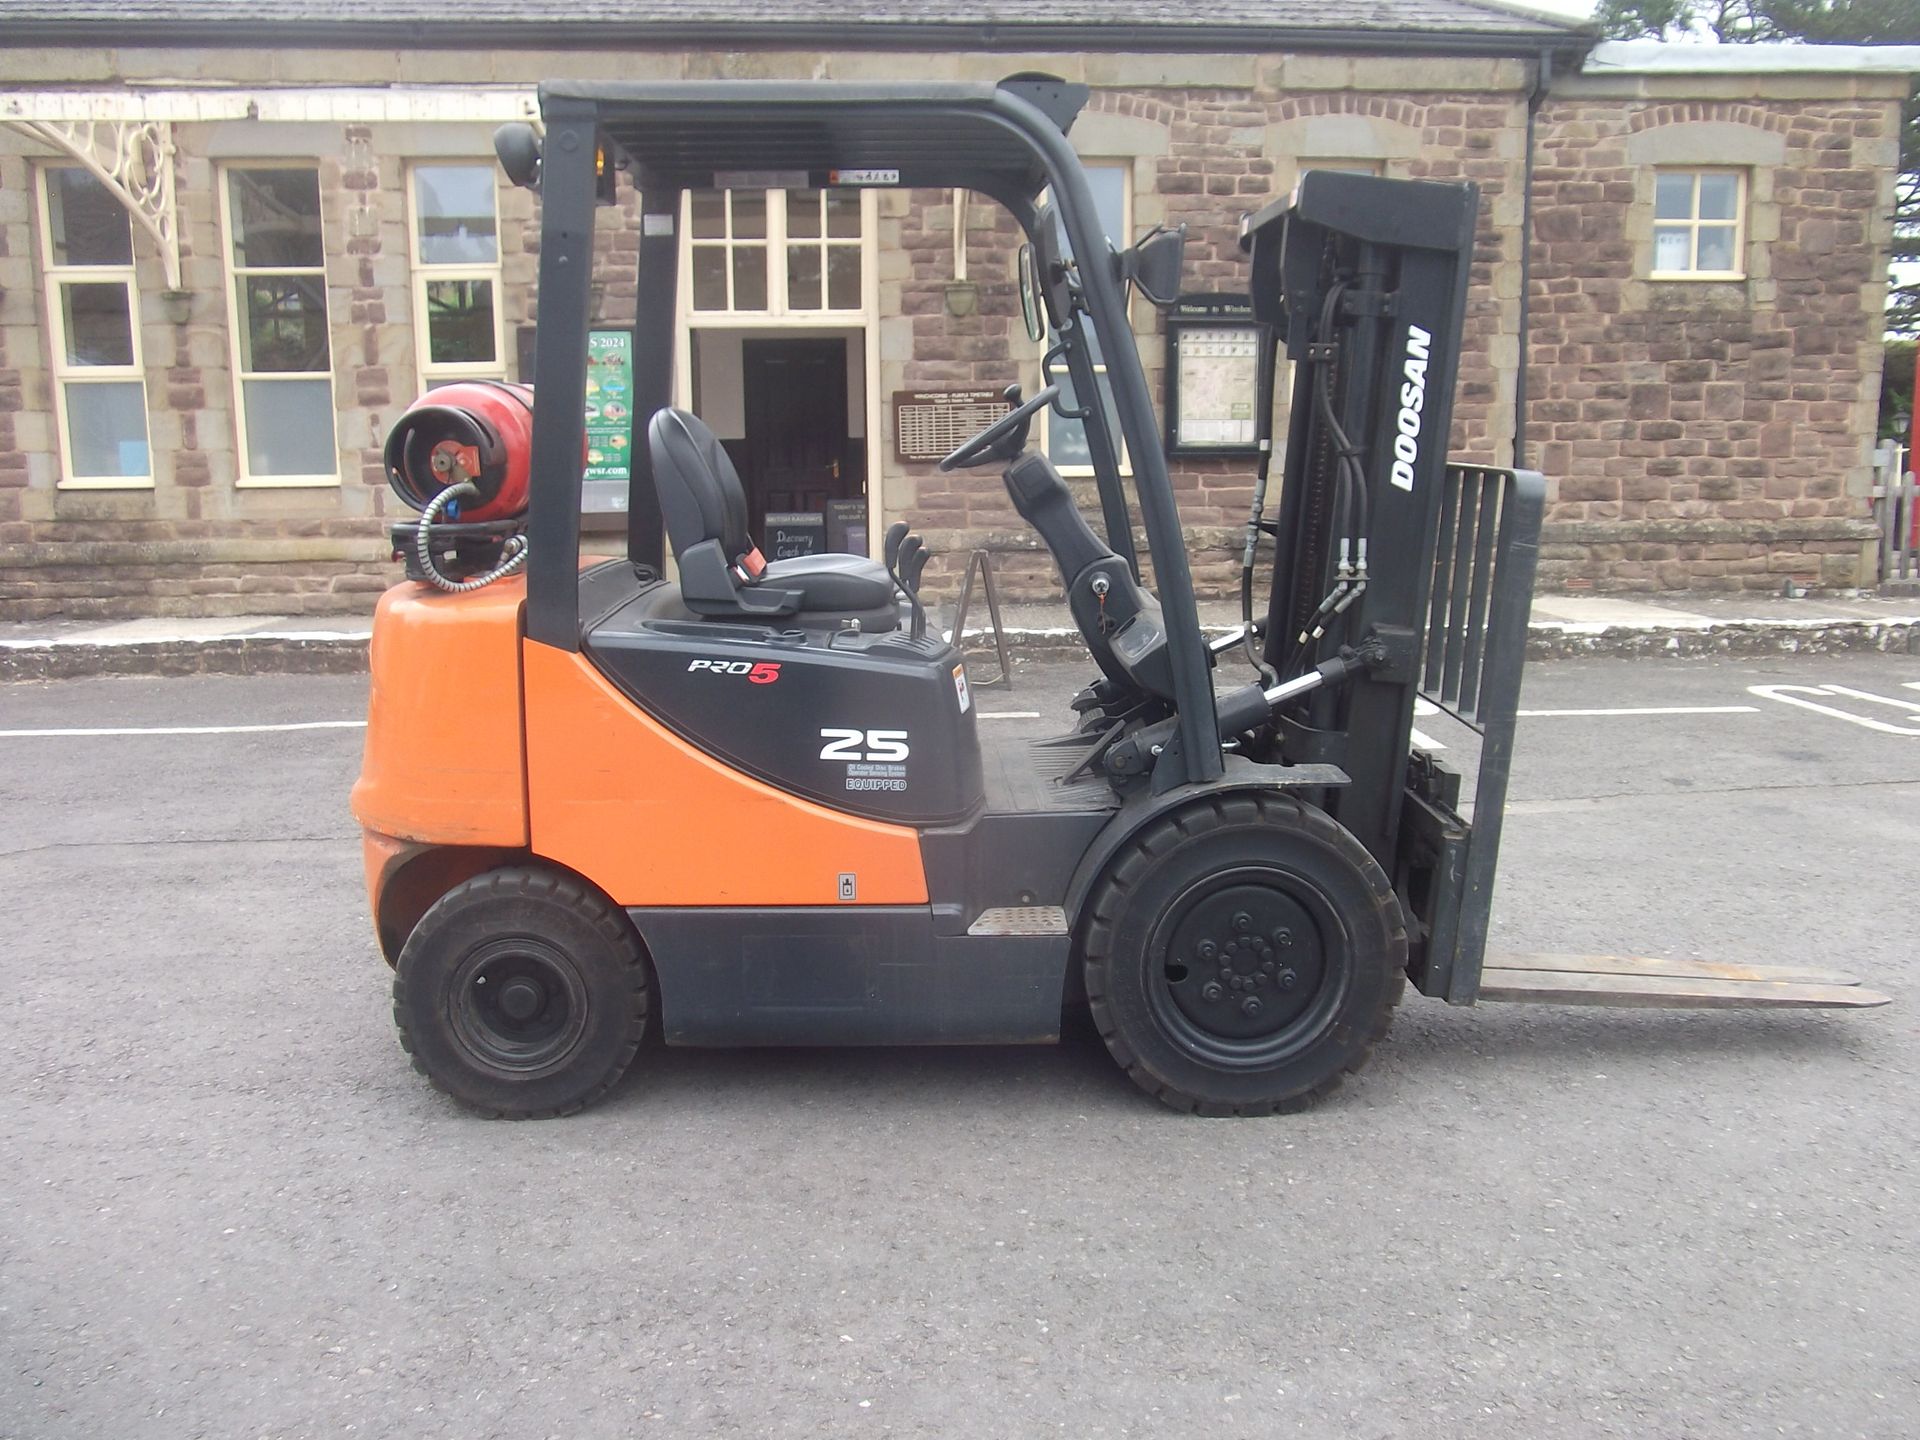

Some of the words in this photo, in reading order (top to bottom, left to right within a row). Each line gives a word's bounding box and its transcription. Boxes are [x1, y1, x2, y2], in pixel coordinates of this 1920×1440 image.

[1180, 304, 1208, 313] Welcome
[1212, 305, 1219, 313] to
[600, 337, 625, 348] 2024
[1391, 324, 1431, 492] DOOSAN
[820, 728, 909, 762] 25
[846, 778, 907, 791] EQUIPPED
